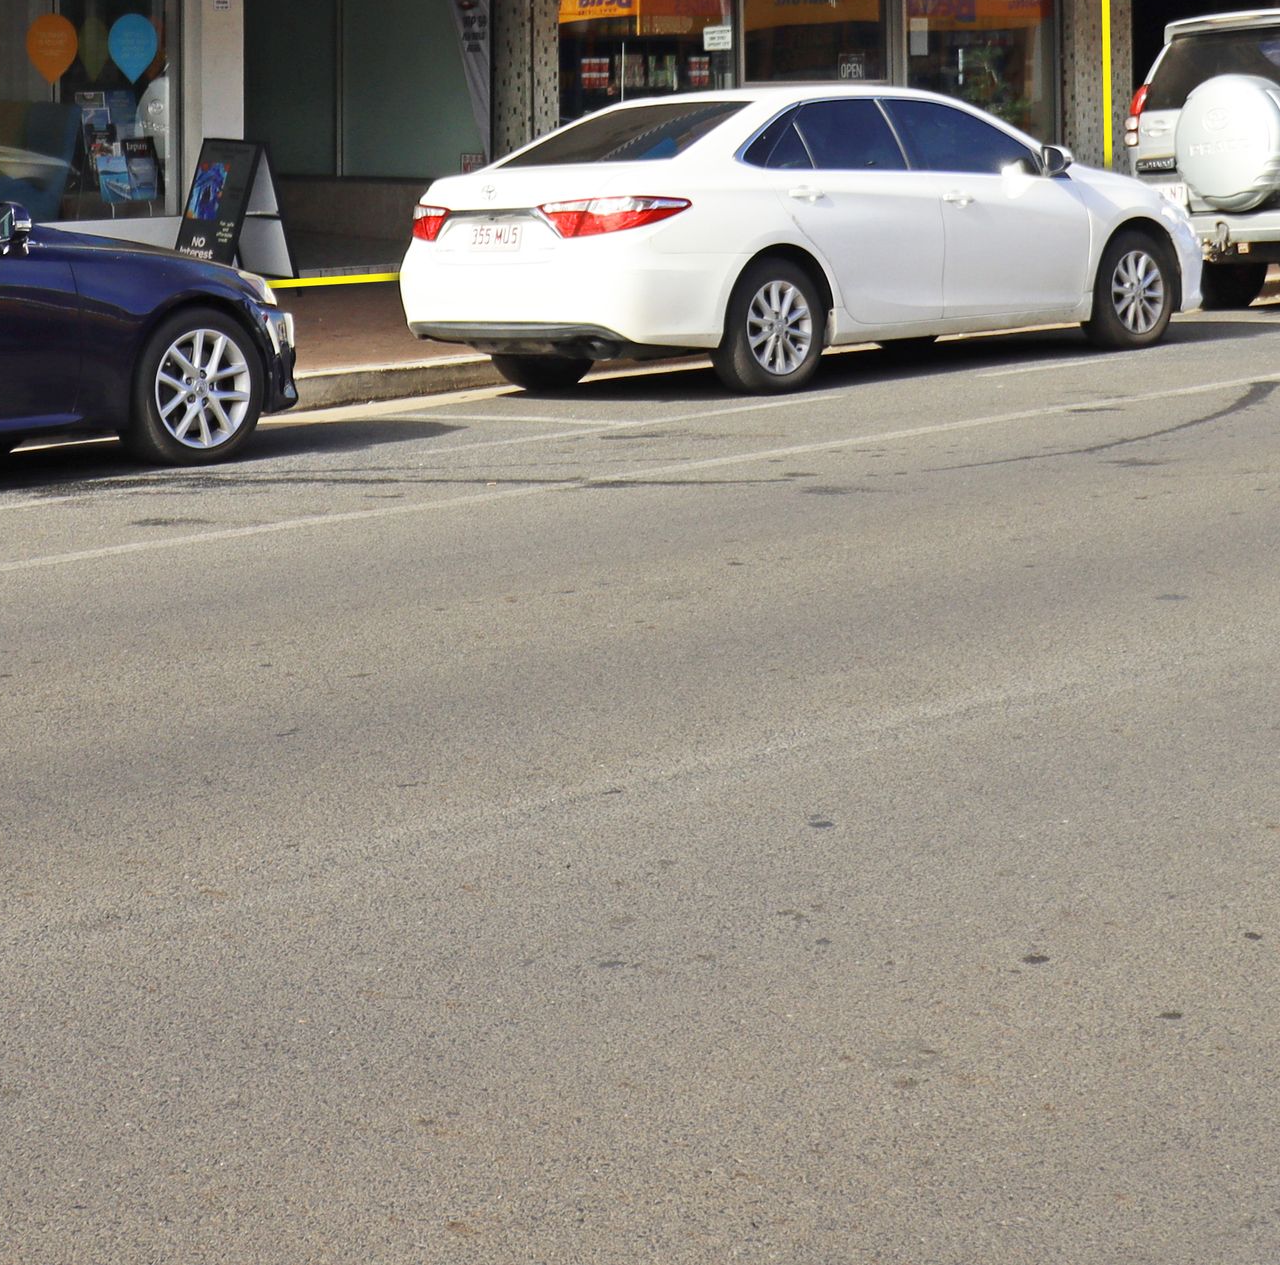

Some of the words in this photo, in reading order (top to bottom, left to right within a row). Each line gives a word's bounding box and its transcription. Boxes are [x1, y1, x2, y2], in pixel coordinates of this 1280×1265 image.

[841, 63, 863, 78] OPEN
[191, 236, 206, 247] NO
[179, 247, 214, 260] Interest
